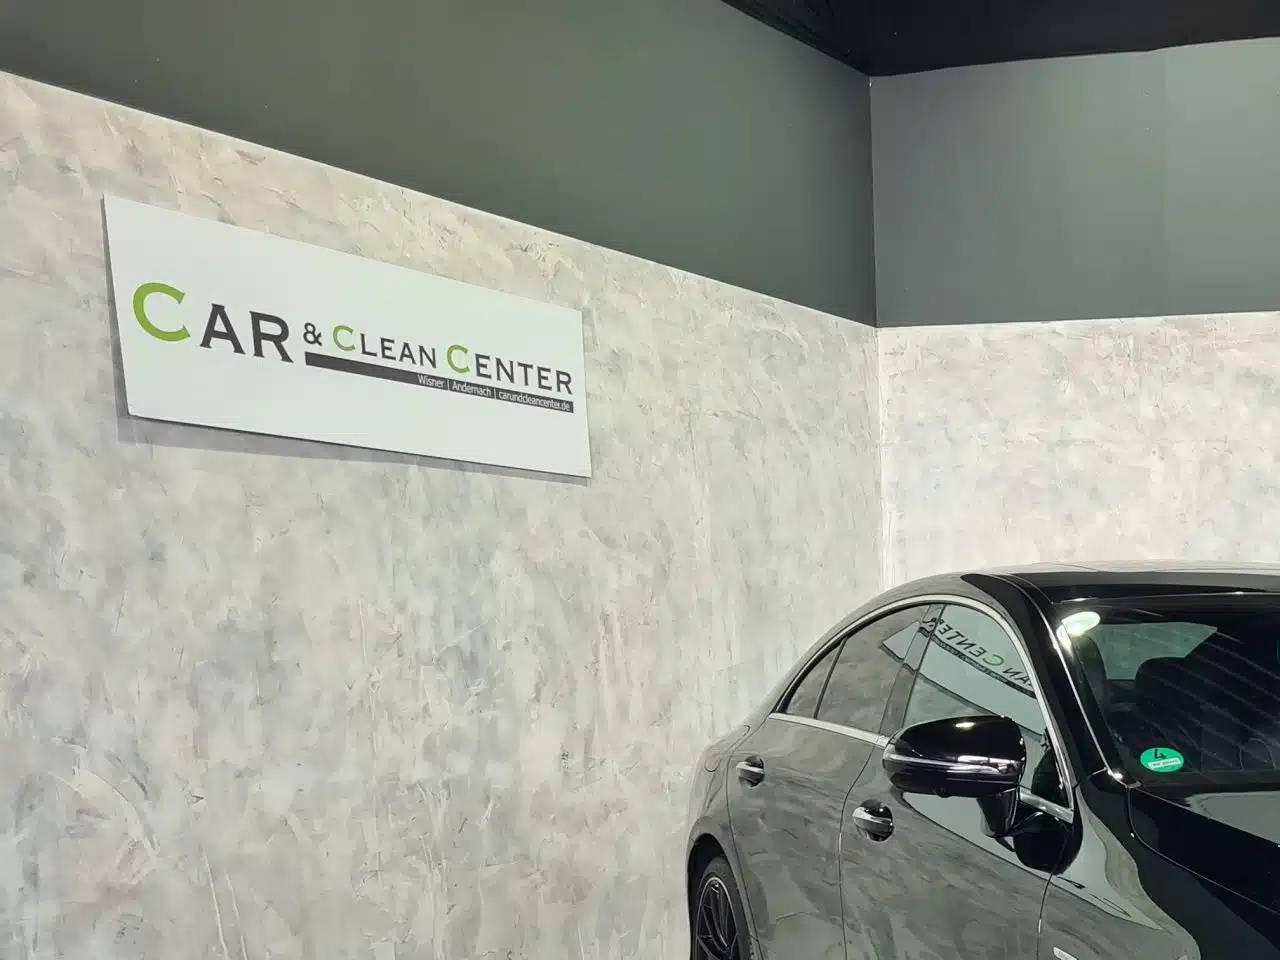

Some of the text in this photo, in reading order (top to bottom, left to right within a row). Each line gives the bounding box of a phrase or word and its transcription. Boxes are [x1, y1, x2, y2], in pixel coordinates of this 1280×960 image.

[132, 281, 573, 395] CAR & CLEAN CENTER
[418, 374, 571, 412] Wisner Andernach carundcleancenter.de
